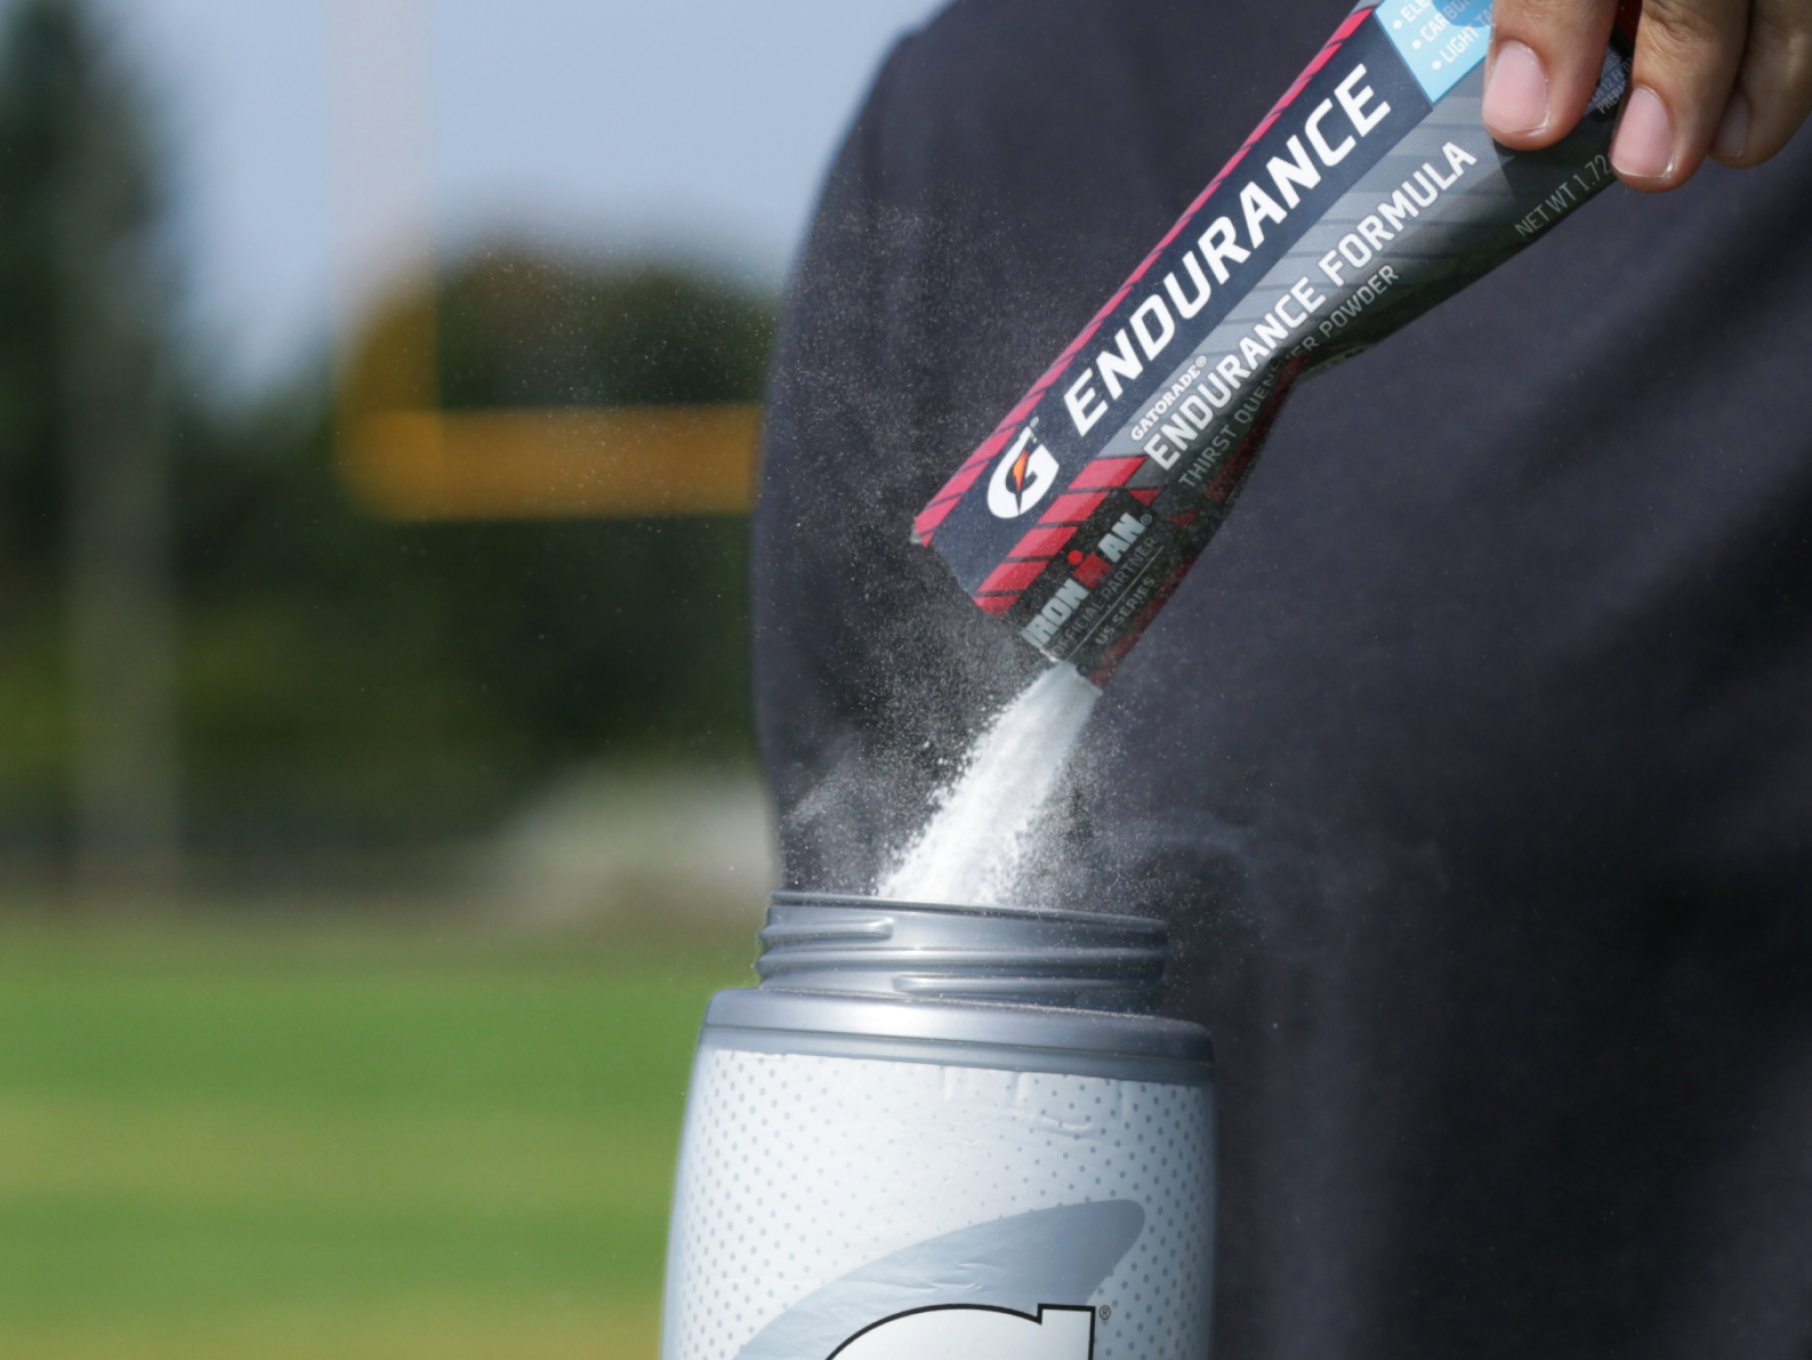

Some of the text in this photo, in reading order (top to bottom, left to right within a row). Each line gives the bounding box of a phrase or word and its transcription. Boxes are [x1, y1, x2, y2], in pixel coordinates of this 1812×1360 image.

[1439, 24, 1480, 63] LIGHT
[1062, 62, 1392, 437] ENDURANCE
[1514, 153, 1613, 237] NET WT 1.72
[1143, 141, 1478, 470] ENDURANCE FORMULA
[1178, 264, 1400, 488] THIRST QUENCER POWDER
[1021, 511, 1146, 647] IRONMAN
[1050, 535, 1159, 658] OFFICIAL PARTNER
[1094, 576, 1156, 646] US SERIES
